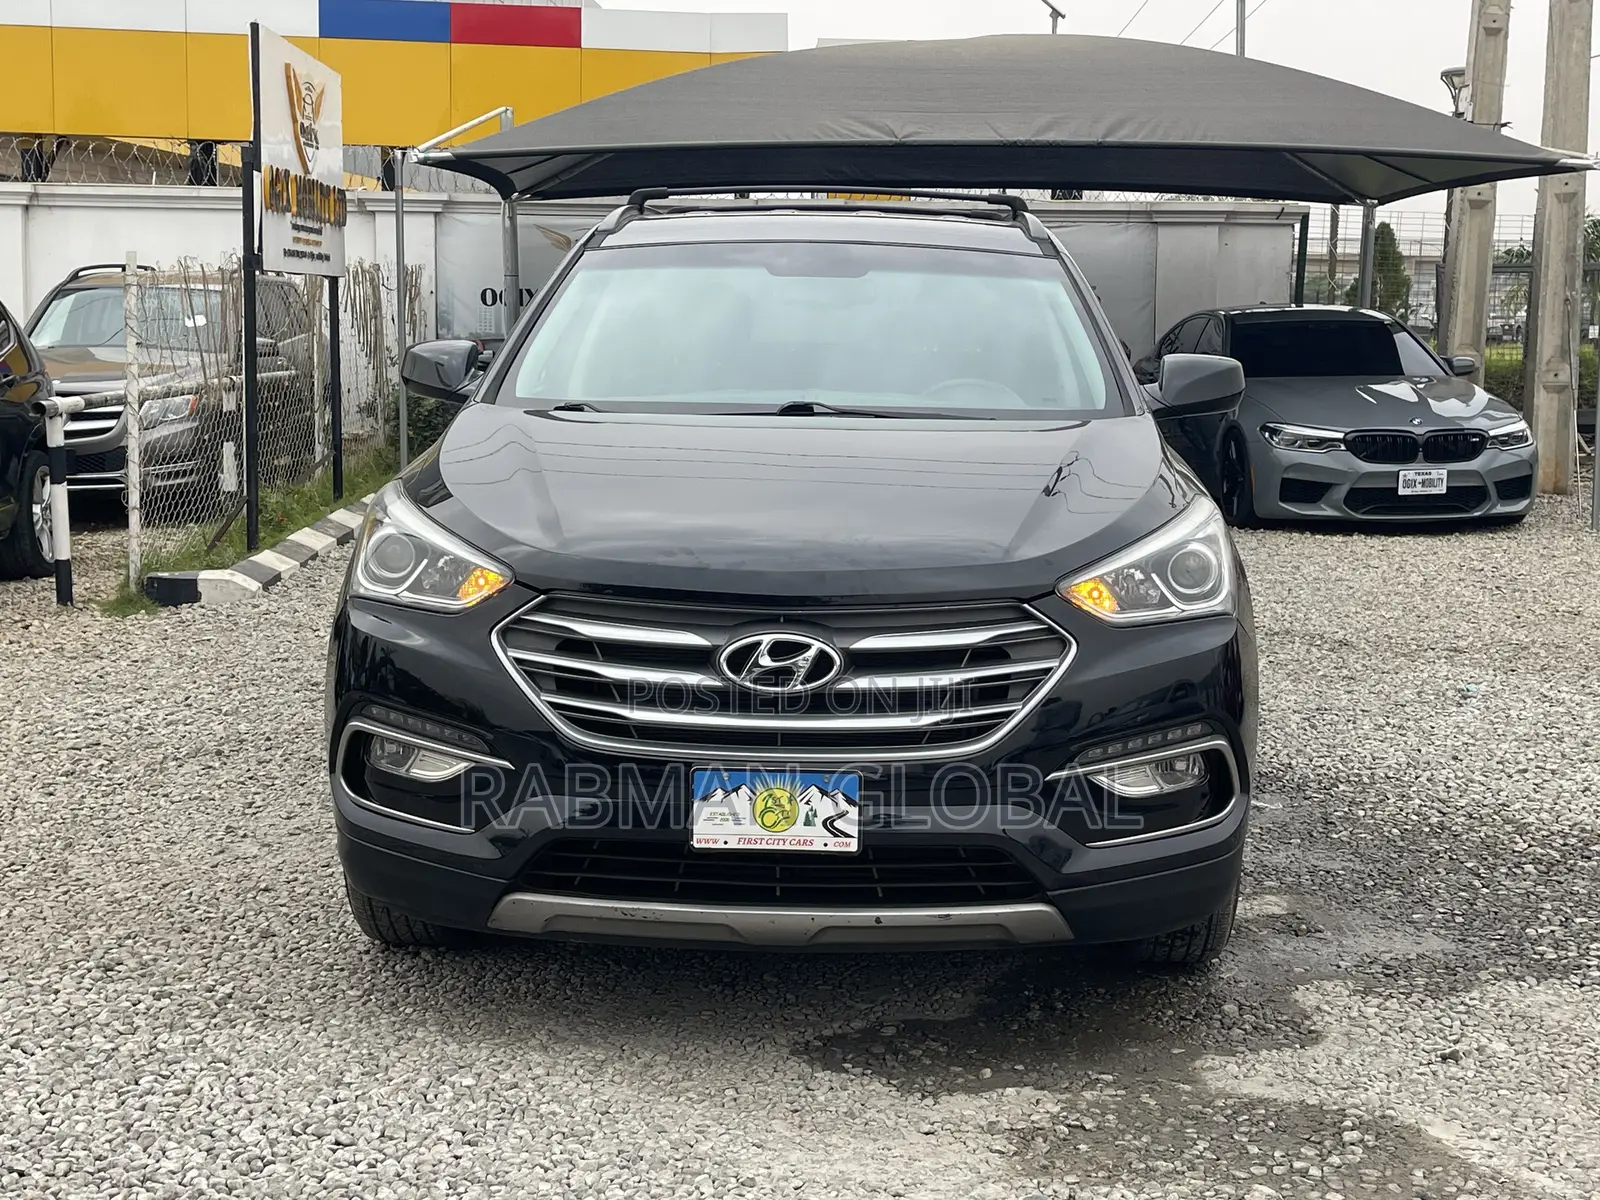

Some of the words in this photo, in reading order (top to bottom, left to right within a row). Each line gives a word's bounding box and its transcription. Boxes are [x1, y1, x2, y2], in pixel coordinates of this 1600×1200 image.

[736, 837, 764, 846] FIRST
[764, 837, 788, 846] CITY
[788, 838, 815, 847] CARS
